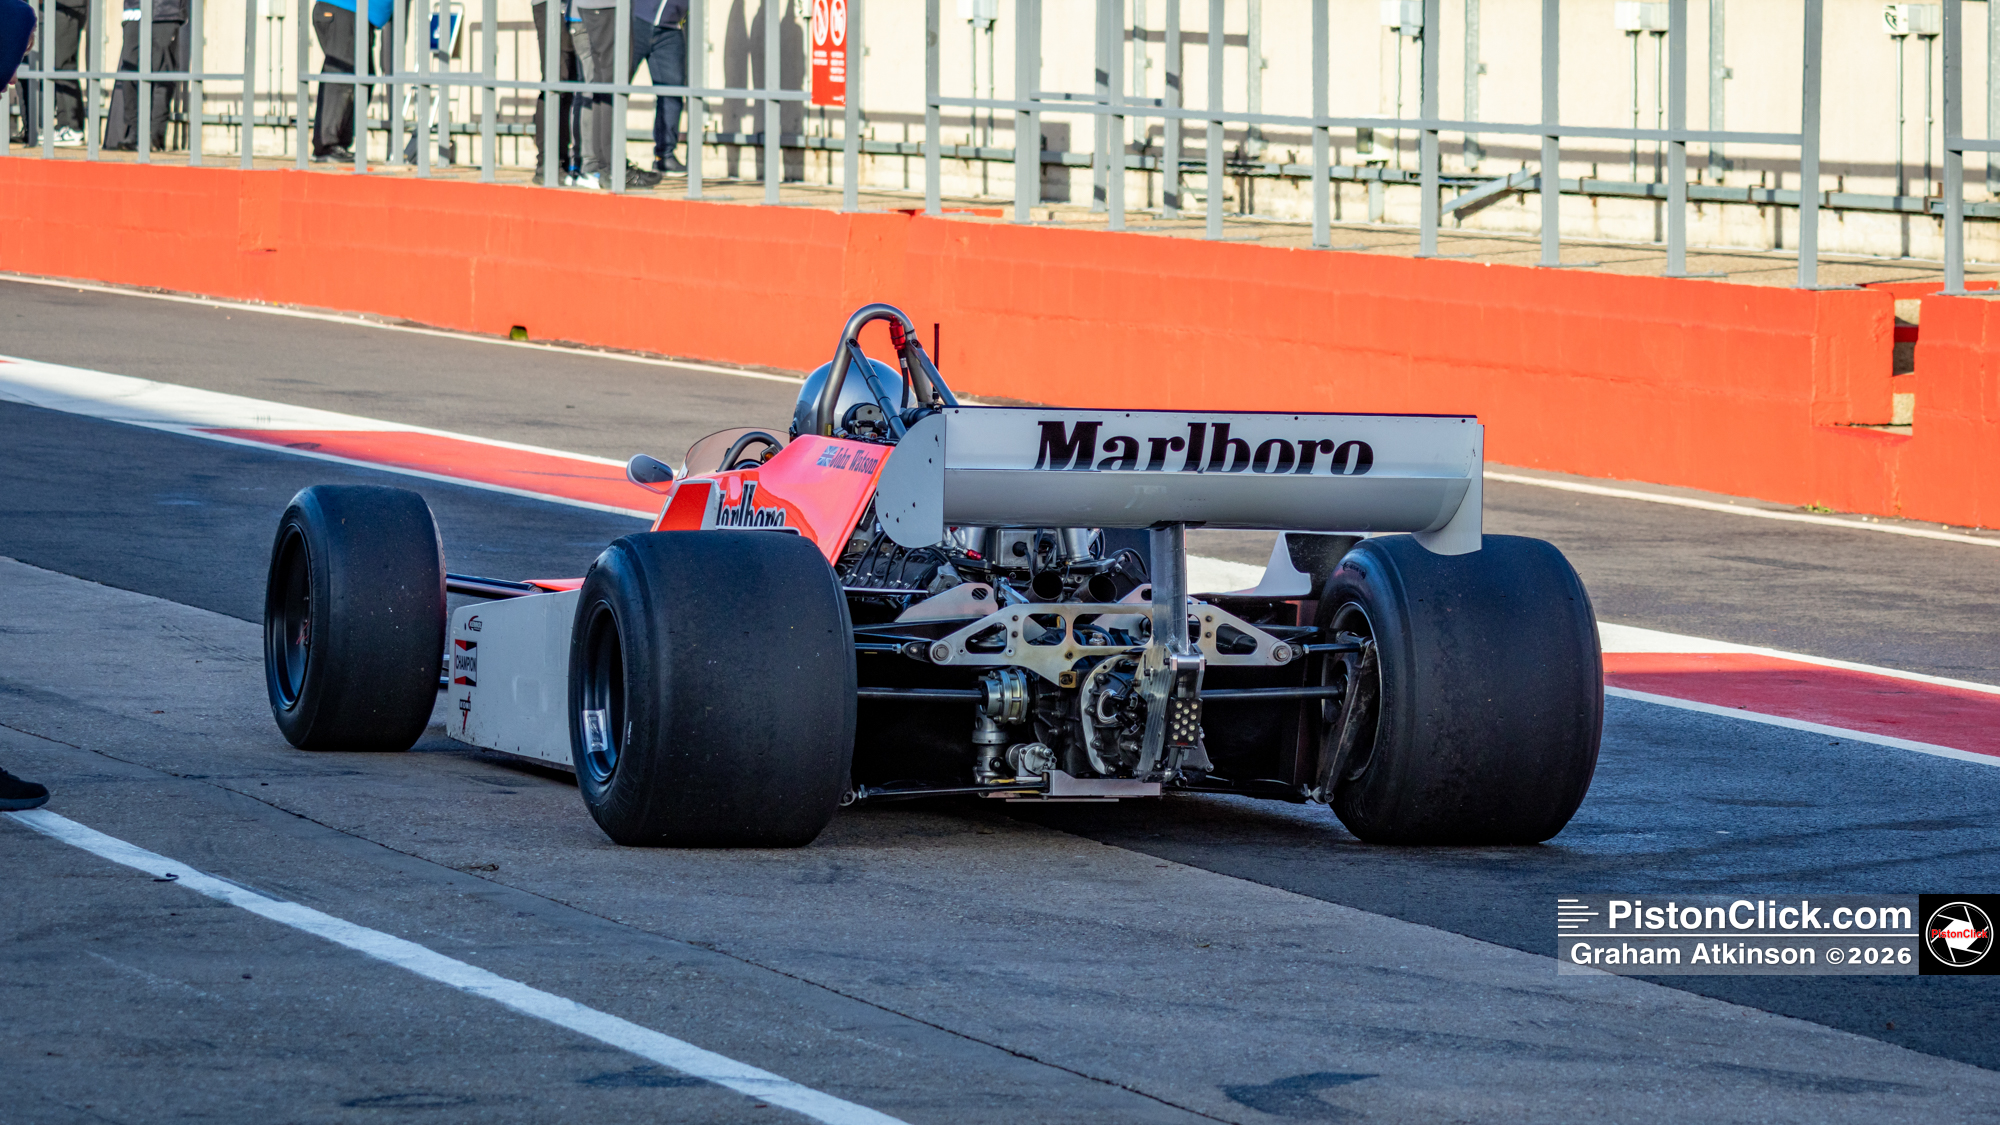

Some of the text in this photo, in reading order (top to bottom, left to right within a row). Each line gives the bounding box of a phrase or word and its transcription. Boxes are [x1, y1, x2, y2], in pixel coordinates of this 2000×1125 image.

[829, 447, 879, 475] John Watson
[1033, 420, 1374, 475] Marlboro
[456, 654, 477, 673] CHAMPION
